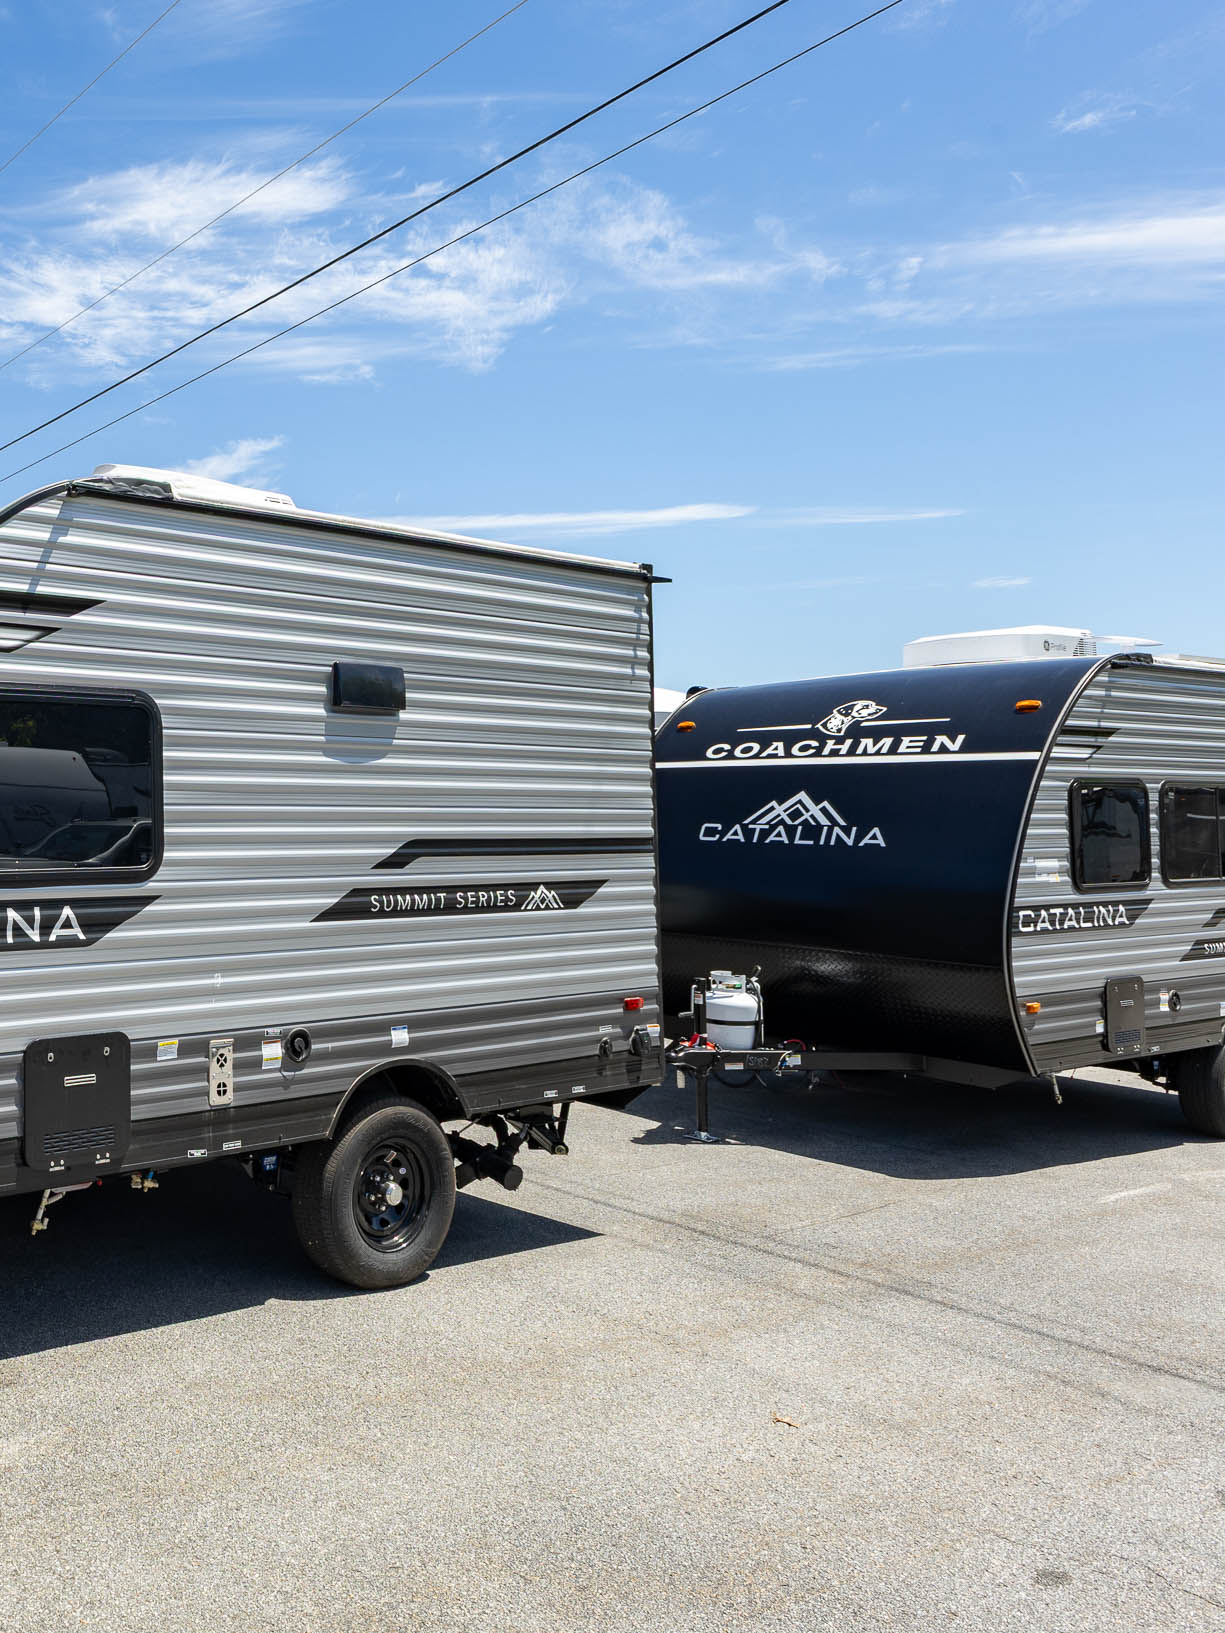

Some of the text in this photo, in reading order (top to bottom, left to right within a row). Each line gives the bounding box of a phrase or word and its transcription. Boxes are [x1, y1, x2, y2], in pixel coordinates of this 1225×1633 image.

[705, 734, 966, 759] COACHMEN
[699, 823, 886, 847] CATALINA
[370, 889, 517, 912] SUMMIT SERIES
[1019, 904, 1130, 932] CATALINA
[1203, 942, 1225, 955] SUM
